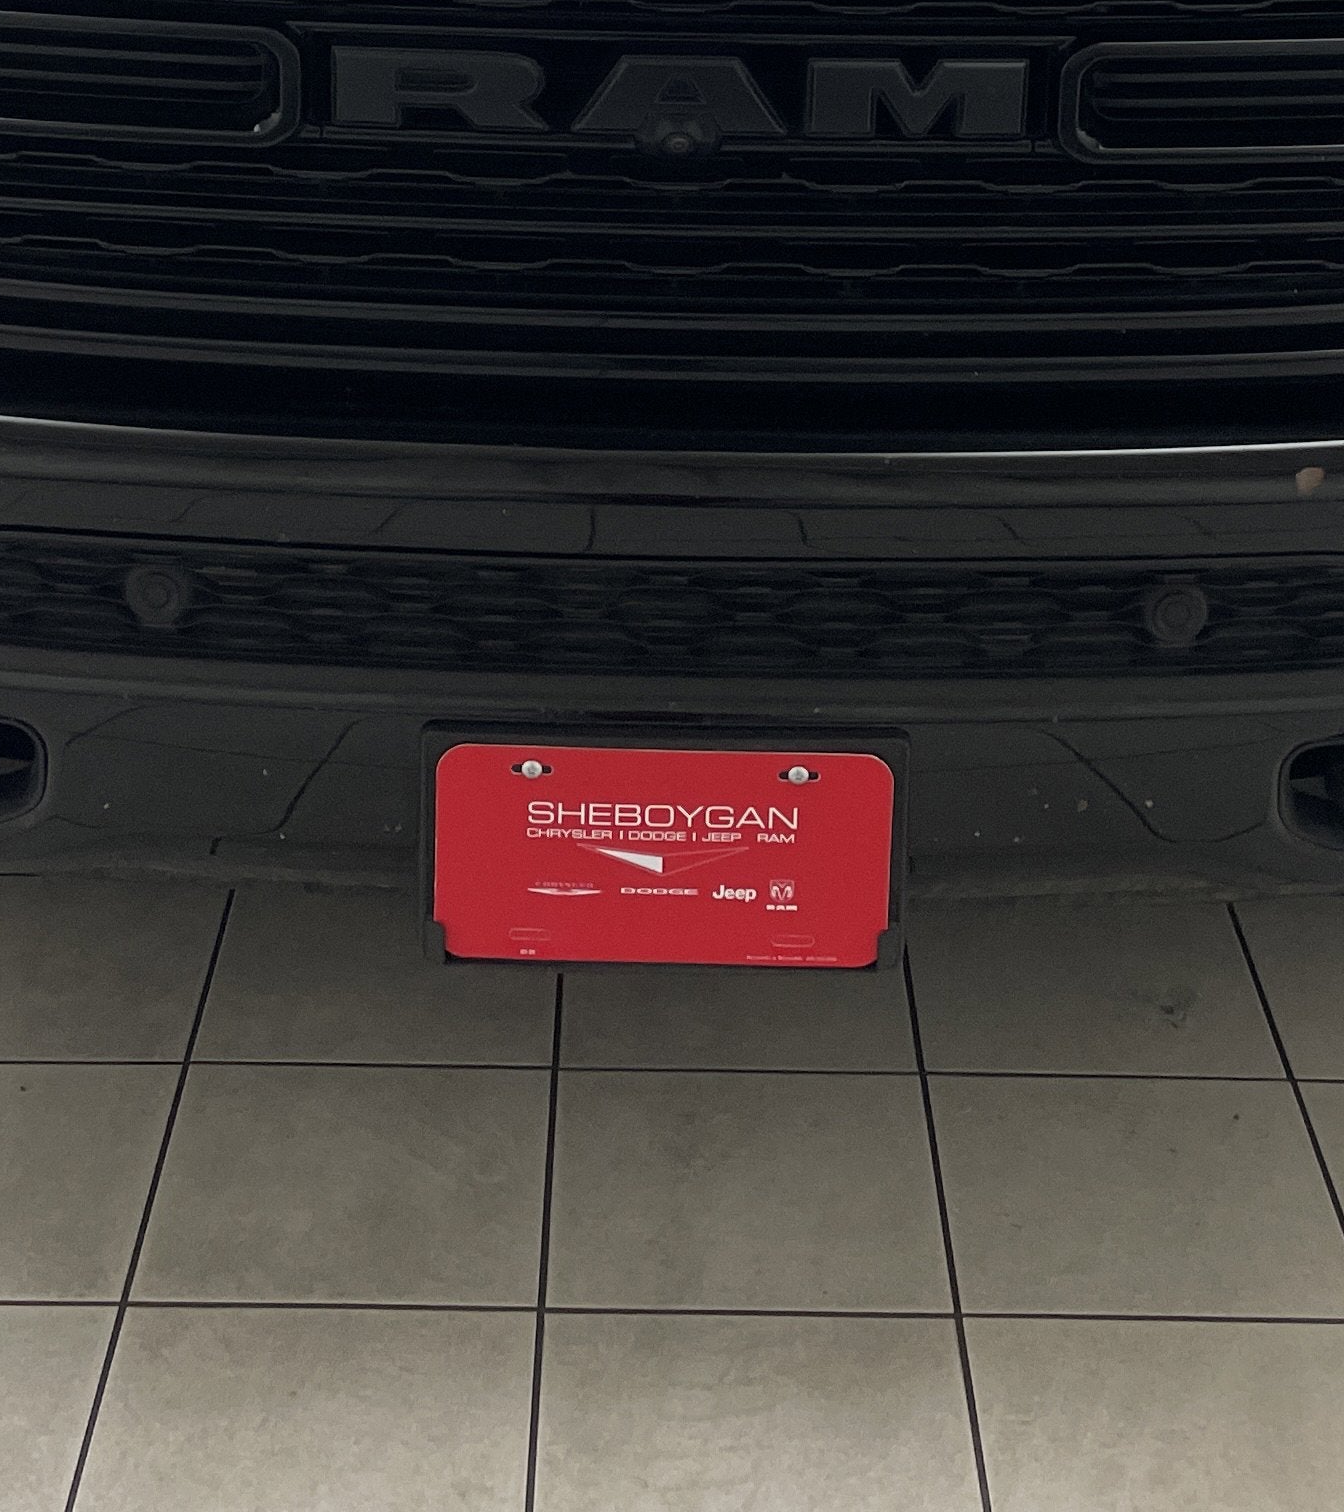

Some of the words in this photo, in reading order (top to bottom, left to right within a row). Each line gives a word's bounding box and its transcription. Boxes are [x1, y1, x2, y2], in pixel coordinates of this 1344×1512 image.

[329, 45, 1029, 136] RAM
[527, 801, 799, 830] SHEBOYGAN
[526, 827, 613, 840] CHRYSLER
[628, 830, 687, 841] DODGE
[701, 832, 742, 842] JEEP
[757, 833, 796, 844] RAM
[712, 884, 757, 903] Jeep
